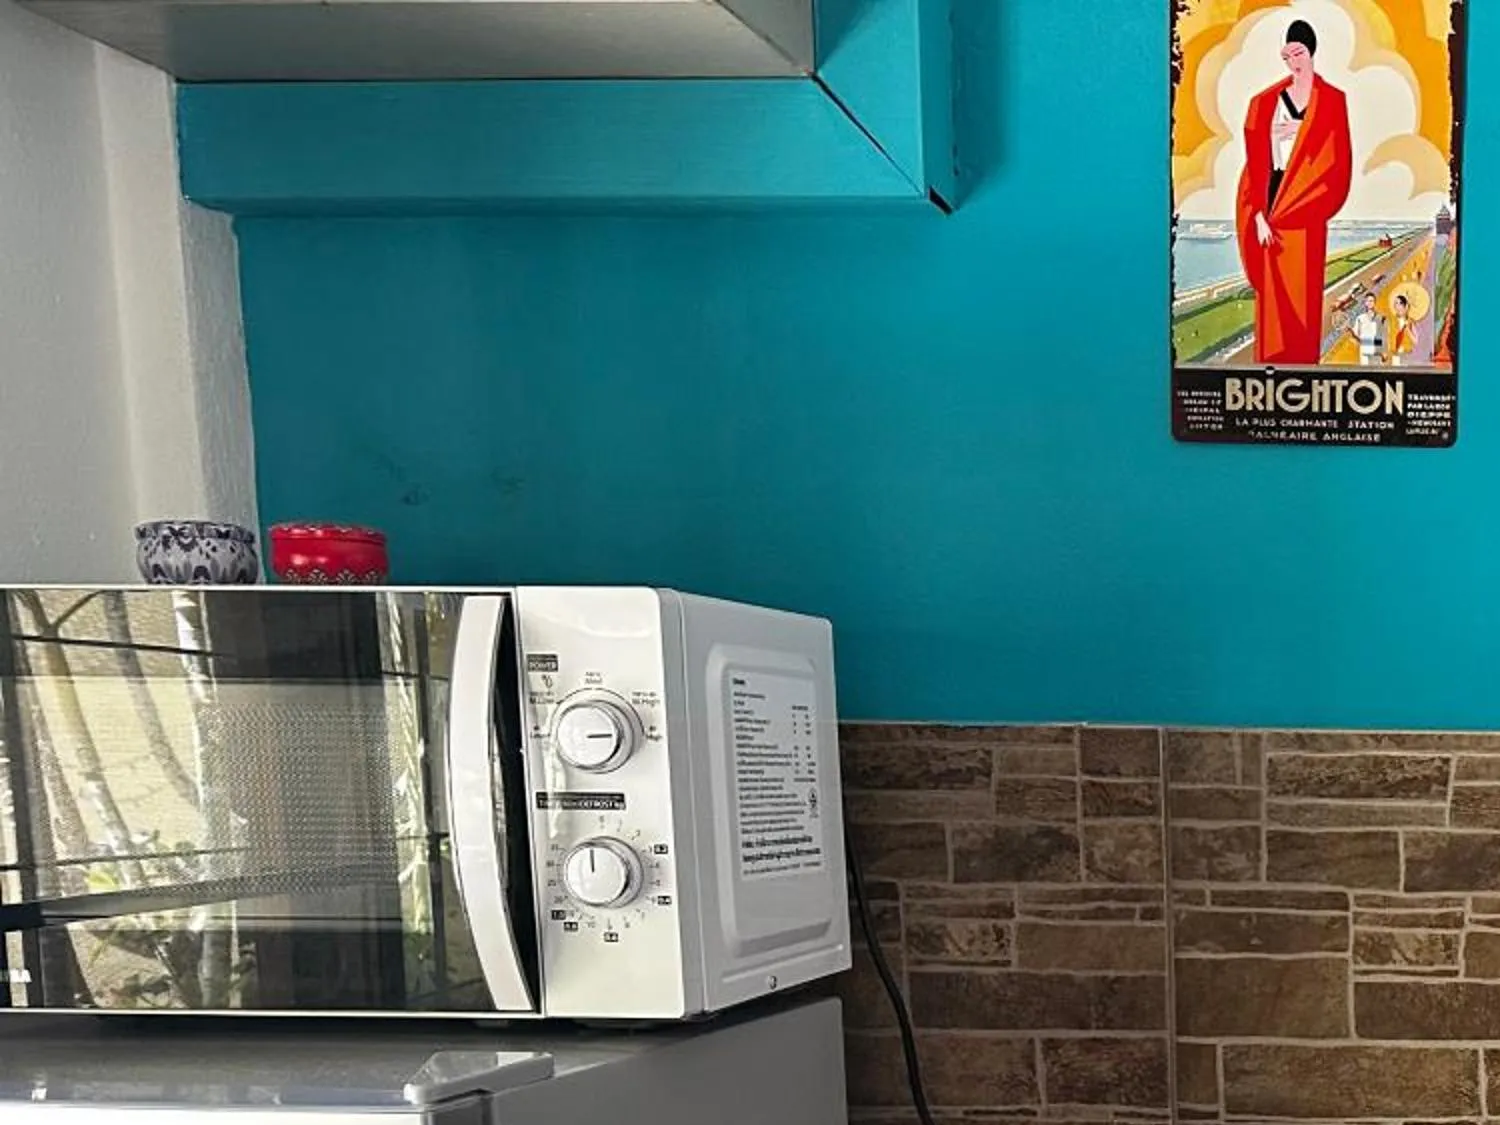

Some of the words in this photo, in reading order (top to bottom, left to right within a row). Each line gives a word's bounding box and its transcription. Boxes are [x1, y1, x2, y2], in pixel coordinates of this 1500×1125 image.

[1225, 377, 1404, 416] BRIGHTON
[1235, 417, 1249, 427] LA
[1252, 418, 1277, 427] PLUS
[1279, 419, 1339, 429] CHARMANTE
[1347, 421, 1395, 430] STATION
[1322, 432, 1381, 443] ANGLAISE
